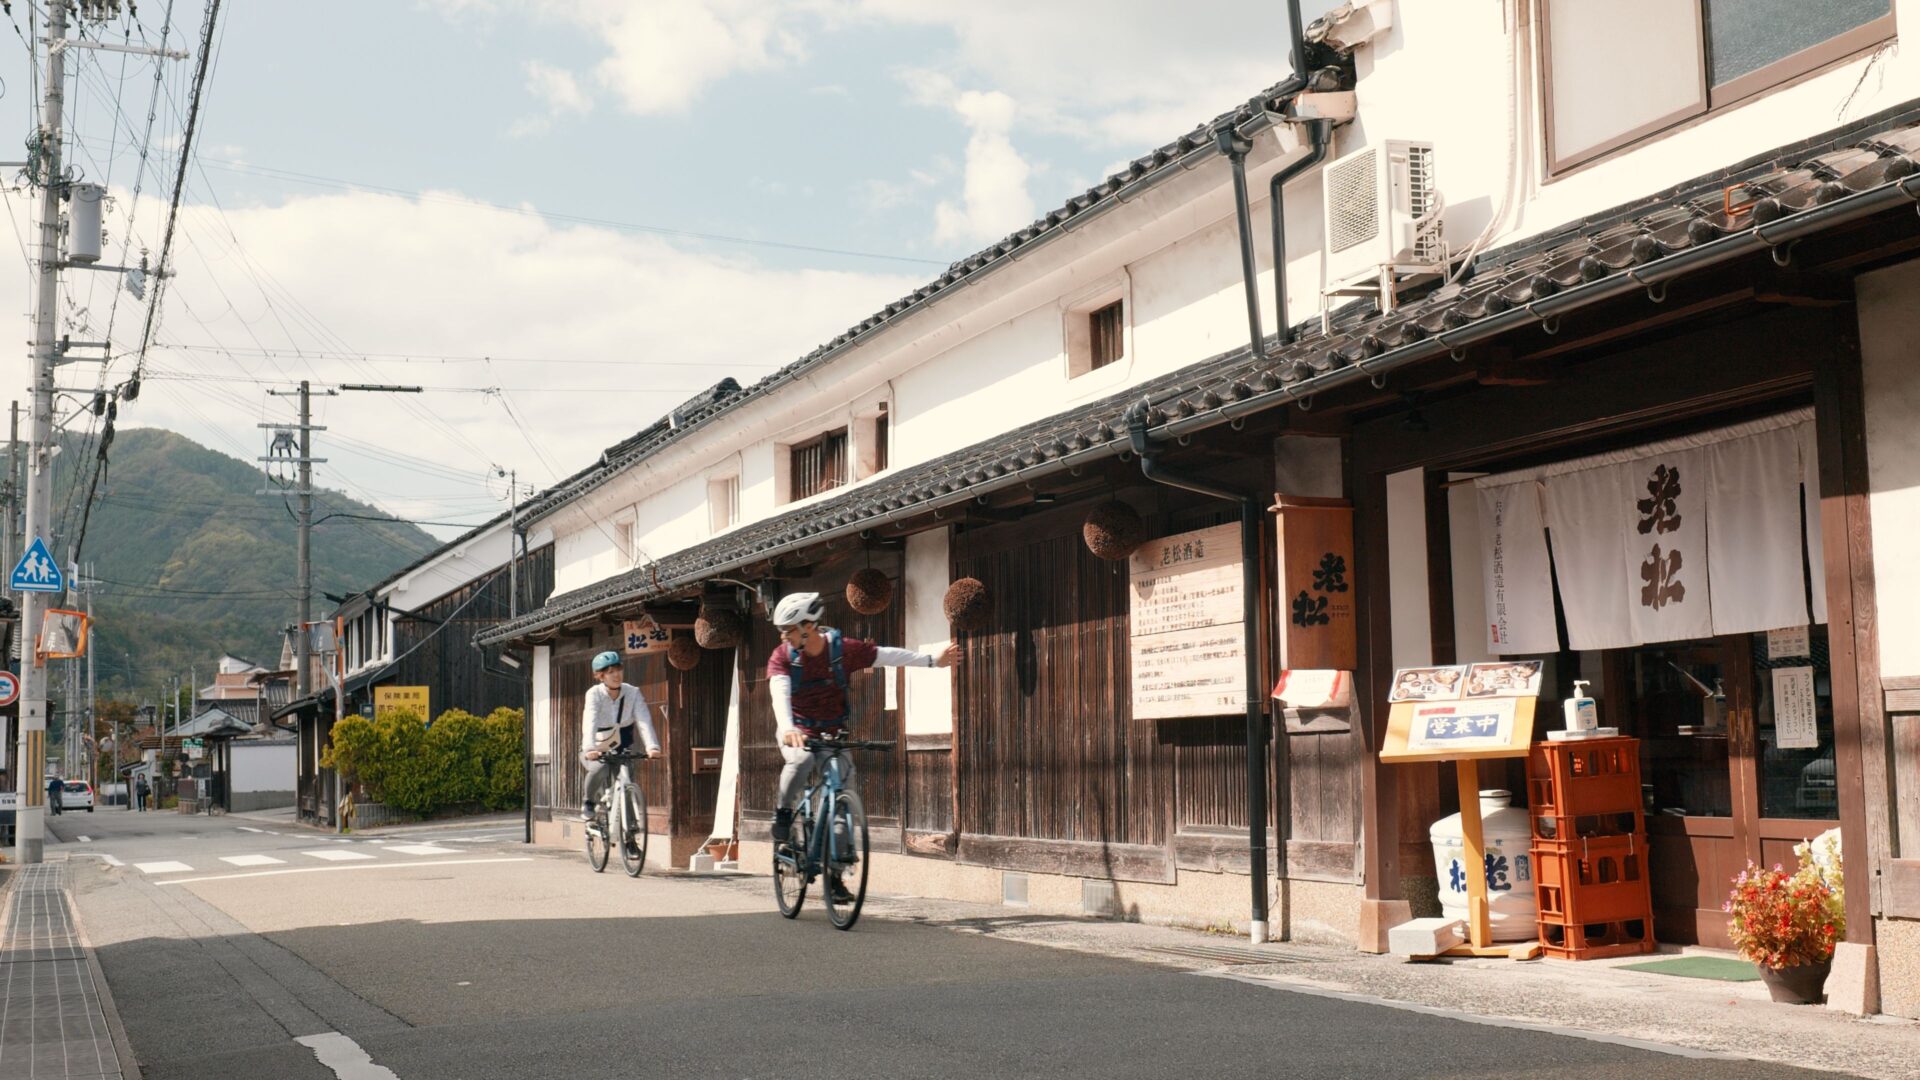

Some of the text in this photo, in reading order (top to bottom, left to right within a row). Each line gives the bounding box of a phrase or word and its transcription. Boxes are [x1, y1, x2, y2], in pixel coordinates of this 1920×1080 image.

[1637, 464, 1685, 611] 老松
[1162, 539, 1204, 565] 老松酒造
[1429, 715, 1497, 736] 営業中
